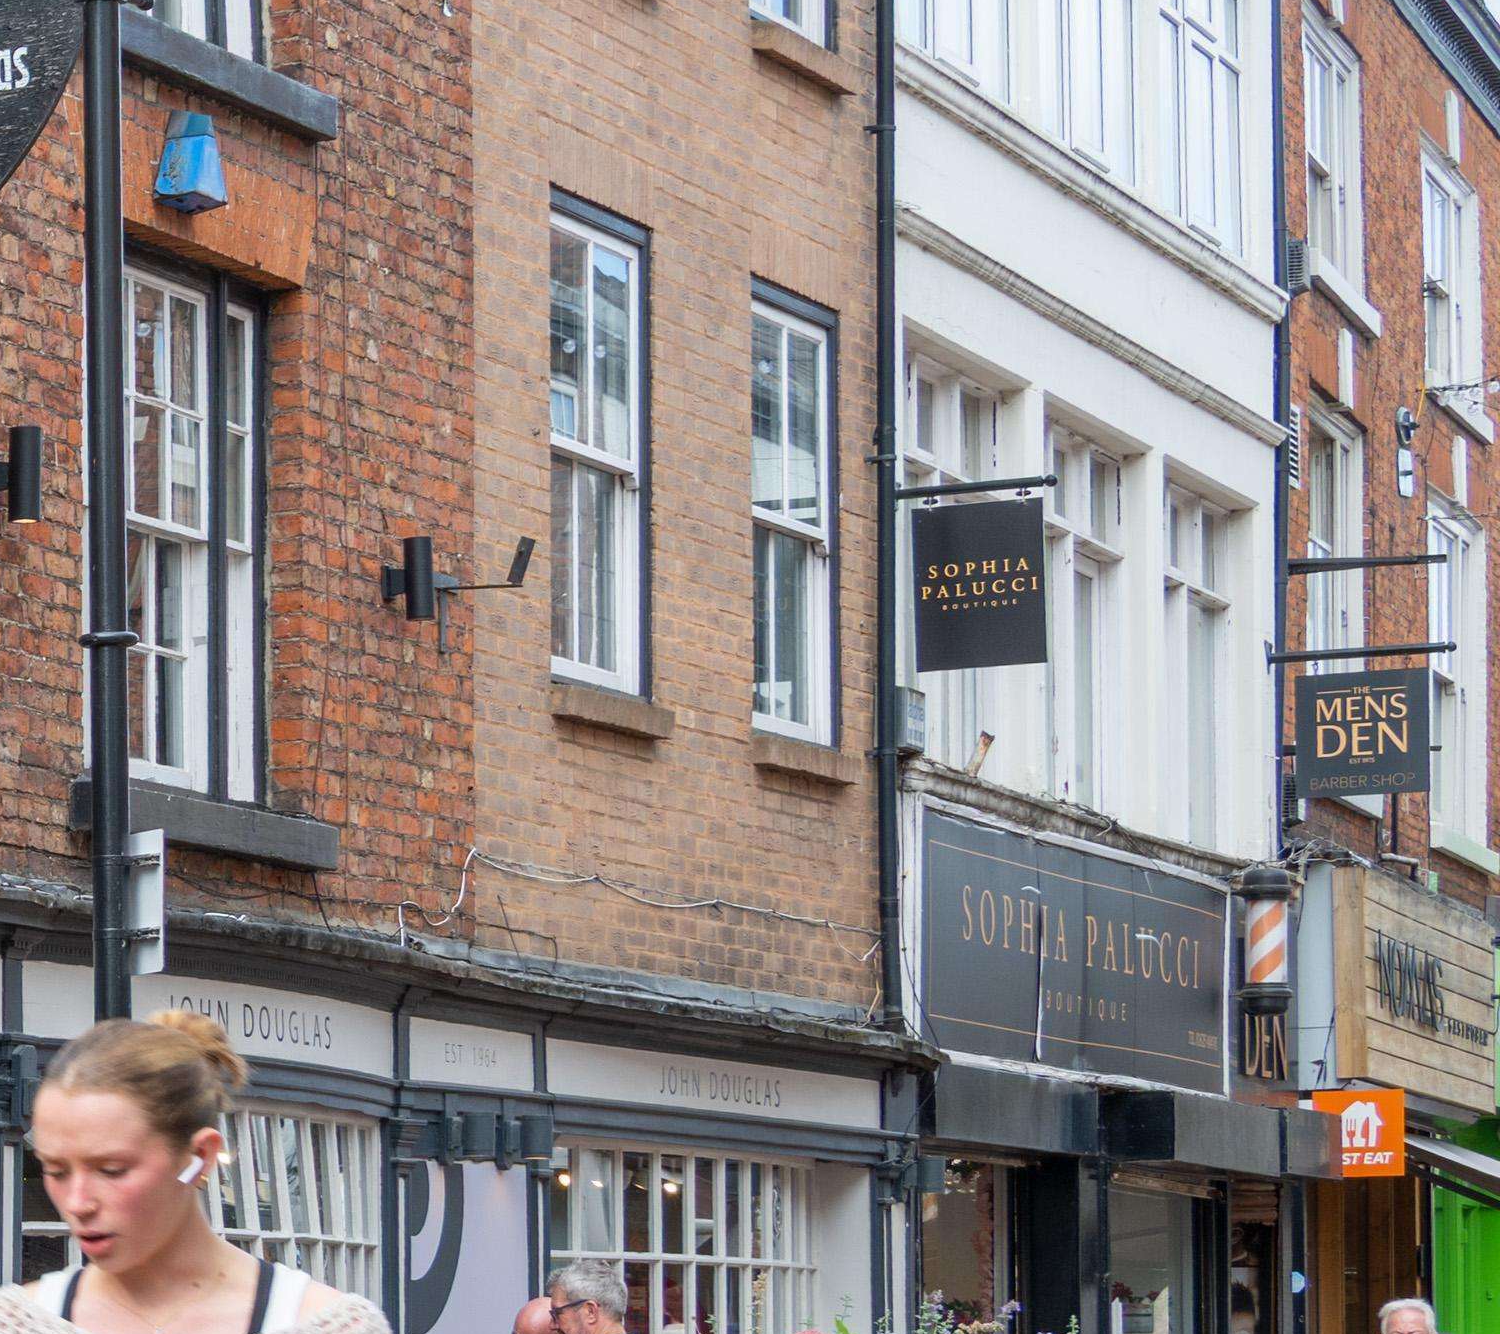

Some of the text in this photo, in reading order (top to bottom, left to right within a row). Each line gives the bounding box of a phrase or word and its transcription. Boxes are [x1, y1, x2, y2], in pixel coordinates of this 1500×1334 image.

[928, 557, 1029, 579] SOPHIA
[921, 576, 1039, 600] PALUCCI
[942, 598, 1018, 611] BOUTIQUE
[1353, 685, 1371, 694] THE
[1316, 693, 1408, 722] MENS
[1316, 719, 1408, 758] DEN
[1310, 772, 1415, 791] BARBER SHOP
[962, 885, 1200, 989] SOPHIA PALUCCI
[1045, 989, 1128, 1023] BOUTIQUE
[243, 1003, 332, 1050] DOUGLAS
[444, 1043, 463, 1065] EST
[1244, 1014, 1288, 1081] DEN
[660, 1066, 781, 1108] JOHN DOUGLAS
[1363, 1151, 1394, 1165] EAT
